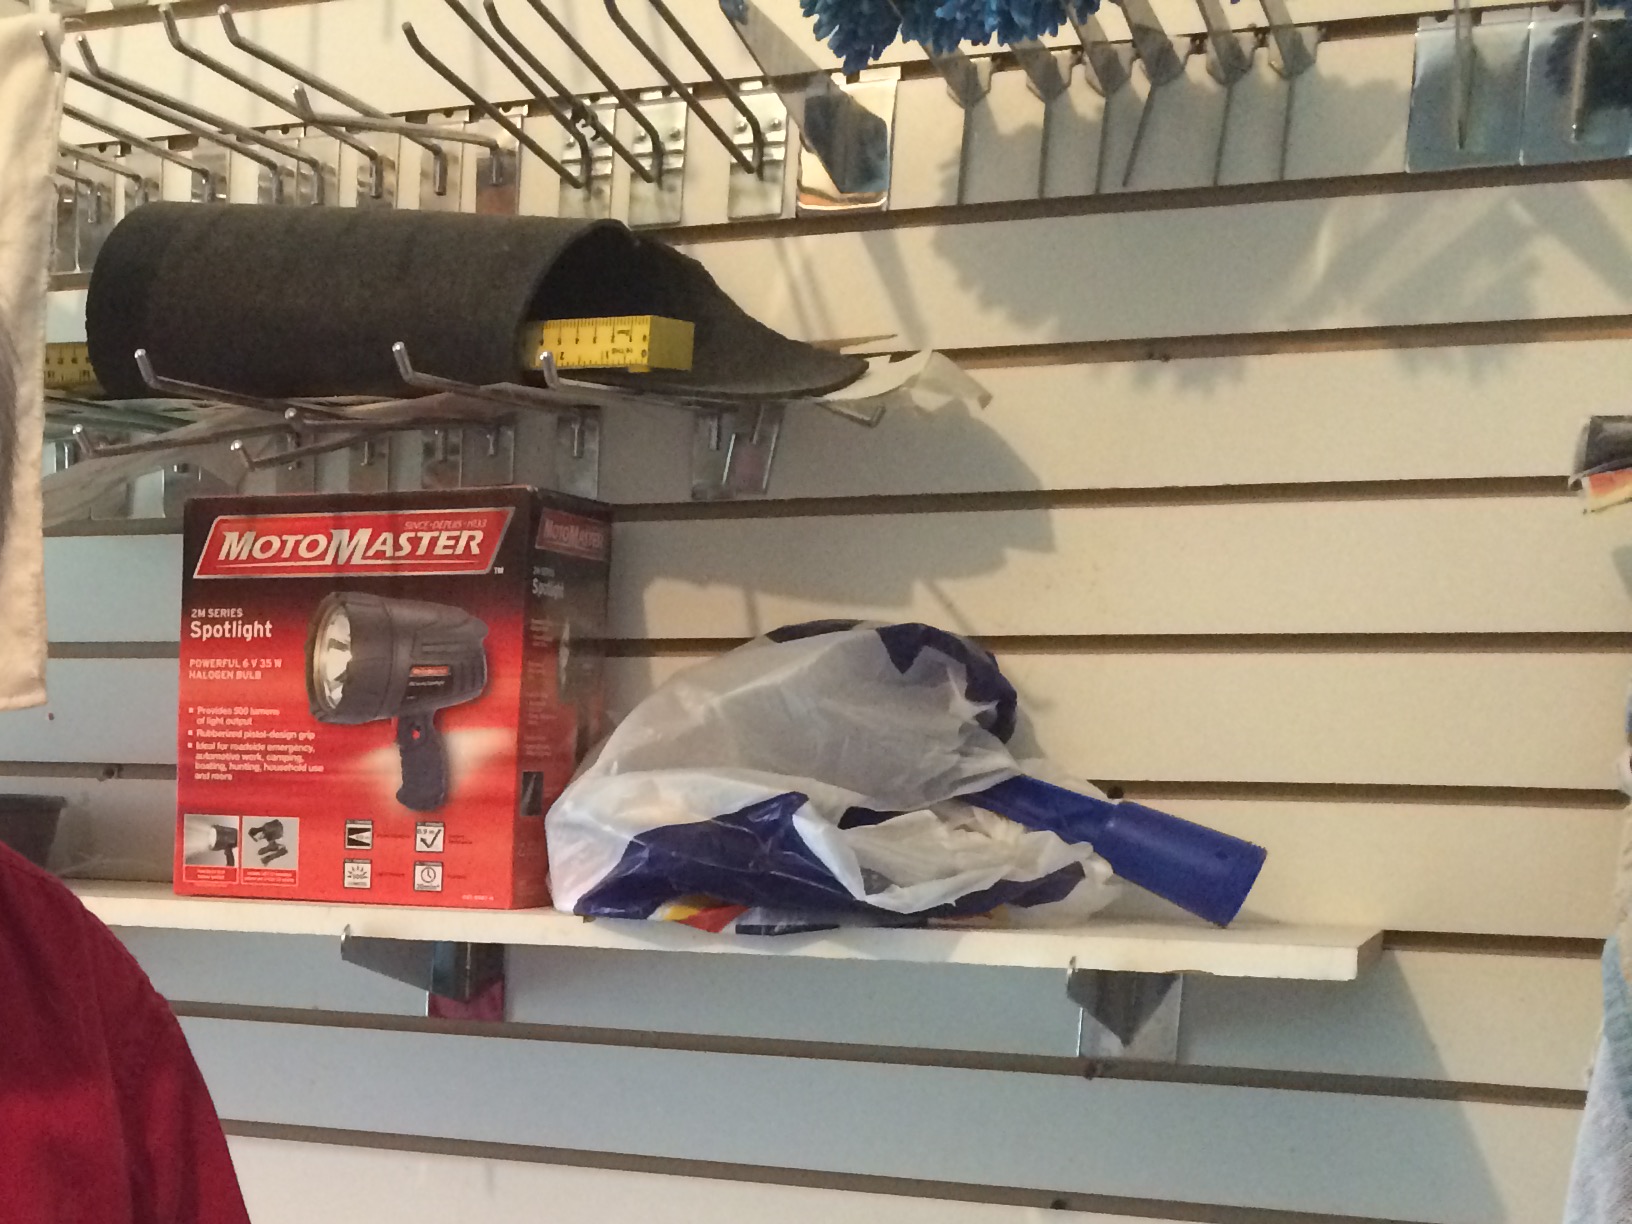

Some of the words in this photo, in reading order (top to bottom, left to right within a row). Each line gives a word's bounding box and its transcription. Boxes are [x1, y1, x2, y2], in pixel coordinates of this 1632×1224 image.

[218, 527, 484, 565] MOTOMASTER
[191, 608, 205, 618] 2M
[207, 608, 244, 618] SERIES
[190, 620, 273, 641] Spotlight
[189, 658, 241, 668] POWERFUL
[259, 658, 272, 668] 35
[273, 658, 283, 668] W
[189, 670, 234, 679] HALOGEN
[236, 670, 262, 680] BULB
[196, 706, 233, 715] Provides
[250, 706, 280, 715] lumens
[196, 716, 205, 725] of
[206, 716, 224, 726] light
[225, 717, 253, 726] output
[196, 728, 243, 738] Rubberized
[243, 730, 297, 740] pistol-design
[298, 730, 316, 741] grip
[196, 741, 215, 750] Ideal
[217, 741, 228, 750] for
[230, 742, 266, 751] roadside
[267, 743, 316, 753] emergency,
[195, 752, 241, 761] automotive
[263, 763, 307, 772] household
[308, 764, 324, 772] use
[194, 772, 210, 780] and
